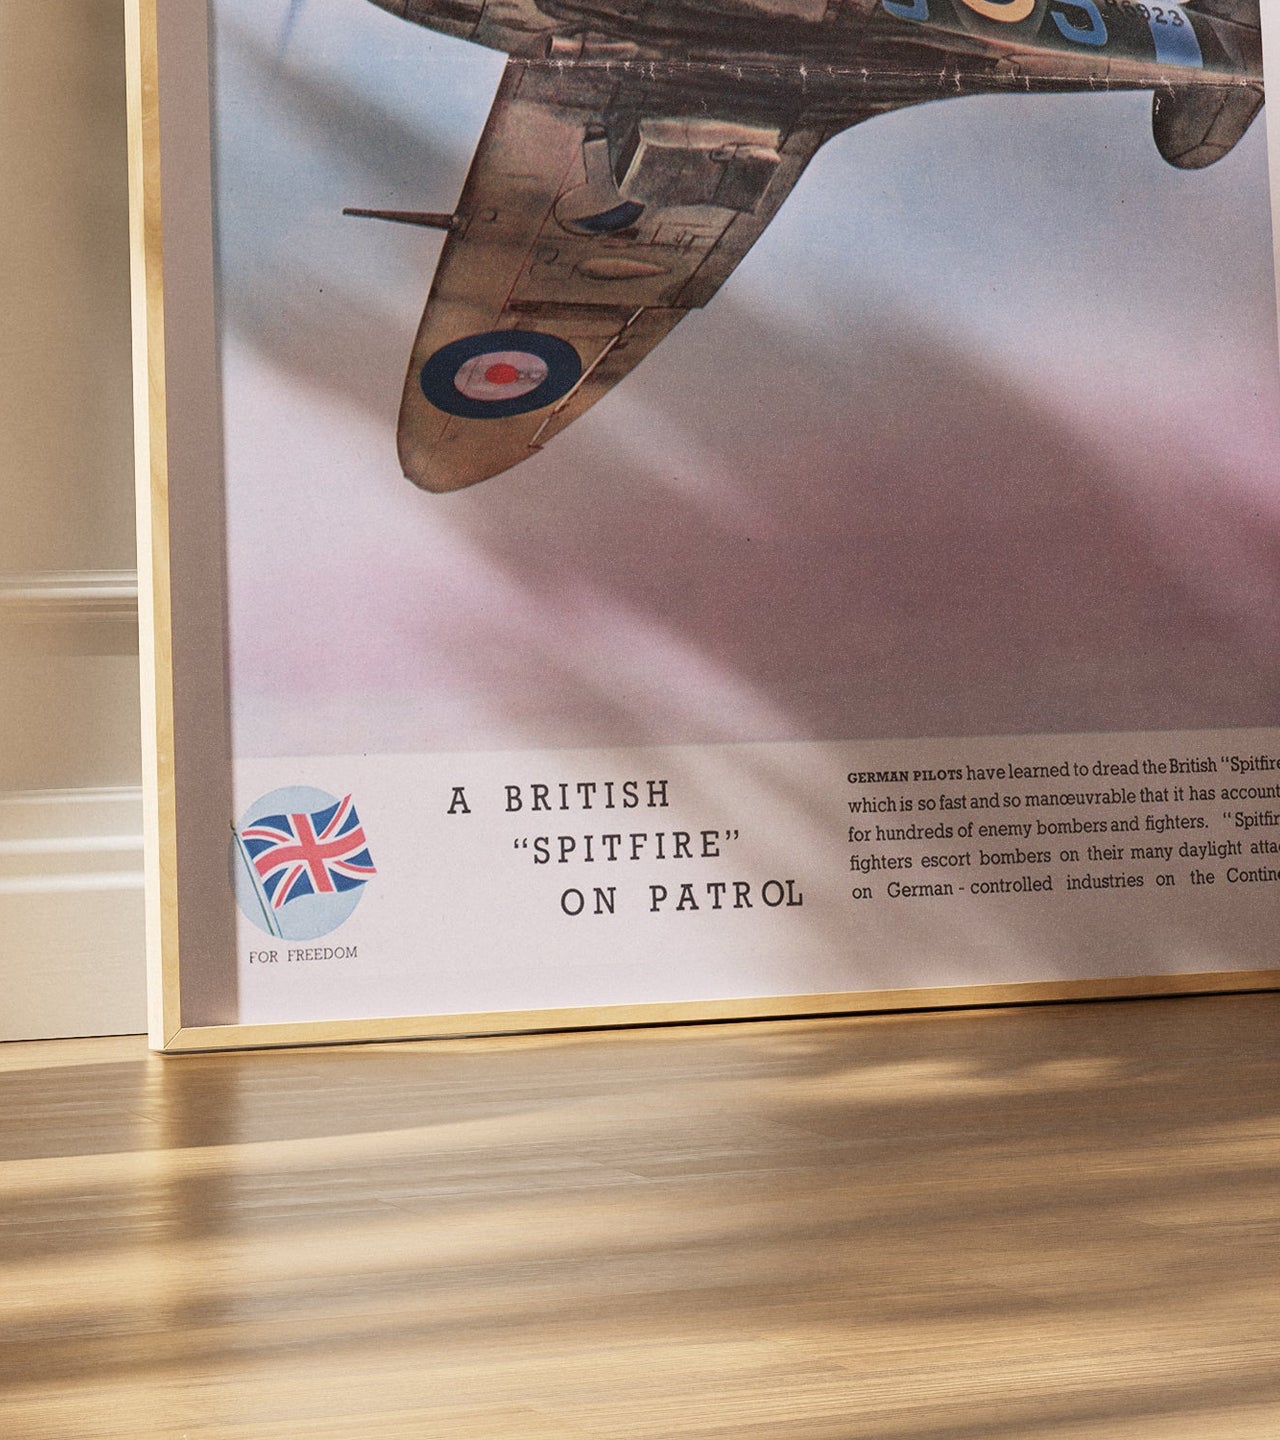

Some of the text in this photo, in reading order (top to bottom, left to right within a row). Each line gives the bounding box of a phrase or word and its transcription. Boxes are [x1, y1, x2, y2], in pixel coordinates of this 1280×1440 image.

[846, 769, 910, 785] GERMAN
[912, 768, 964, 782] PILOTS
[965, 764, 1007, 782] have
[1007, 760, 1071, 780] learned
[1072, 762, 1090, 778] to
[1091, 758, 1141, 777] dread
[1141, 758, 1168, 775] the
[1168, 756, 1218, 775] British
[446, 778, 670, 816] A BRITISH
[847, 795, 898, 814] which
[899, 795, 914, 813] is
[917, 798, 937, 812] so
[938, 793, 968, 811] fast
[969, 791, 1001, 810] and
[1002, 795, 1022, 809] so
[1138, 786, 1170, 804] that
[1172, 785, 1185, 803] it
[1188, 784, 1217, 802] has
[847, 825, 873, 844] for
[874, 821, 954, 842] hundreds
[956, 820, 975, 839] of
[977, 823, 1033, 840] enemy
[1035, 817, 1109, 836] bombers
[1109, 814, 1141, 833] and
[1144, 813, 1210, 835] fighters.
[849, 853, 914, 875] fighters
[920, 851, 972, 869] escort
[978, 847, 1052, 867] bombers
[1058, 849, 1081, 863] on
[1086, 843, 1125, 862] their
[1129, 846, 1174, 863] many
[1177, 839, 1243, 861] daylight
[559, 878, 804, 917] ON PATROL
[851, 886, 874, 901] on
[1065, 871, 1145, 891] industries
[1154, 873, 1176, 887] on
[1189, 868, 1216, 886] the
[248, 945, 358, 965] FOR FREEDOM
